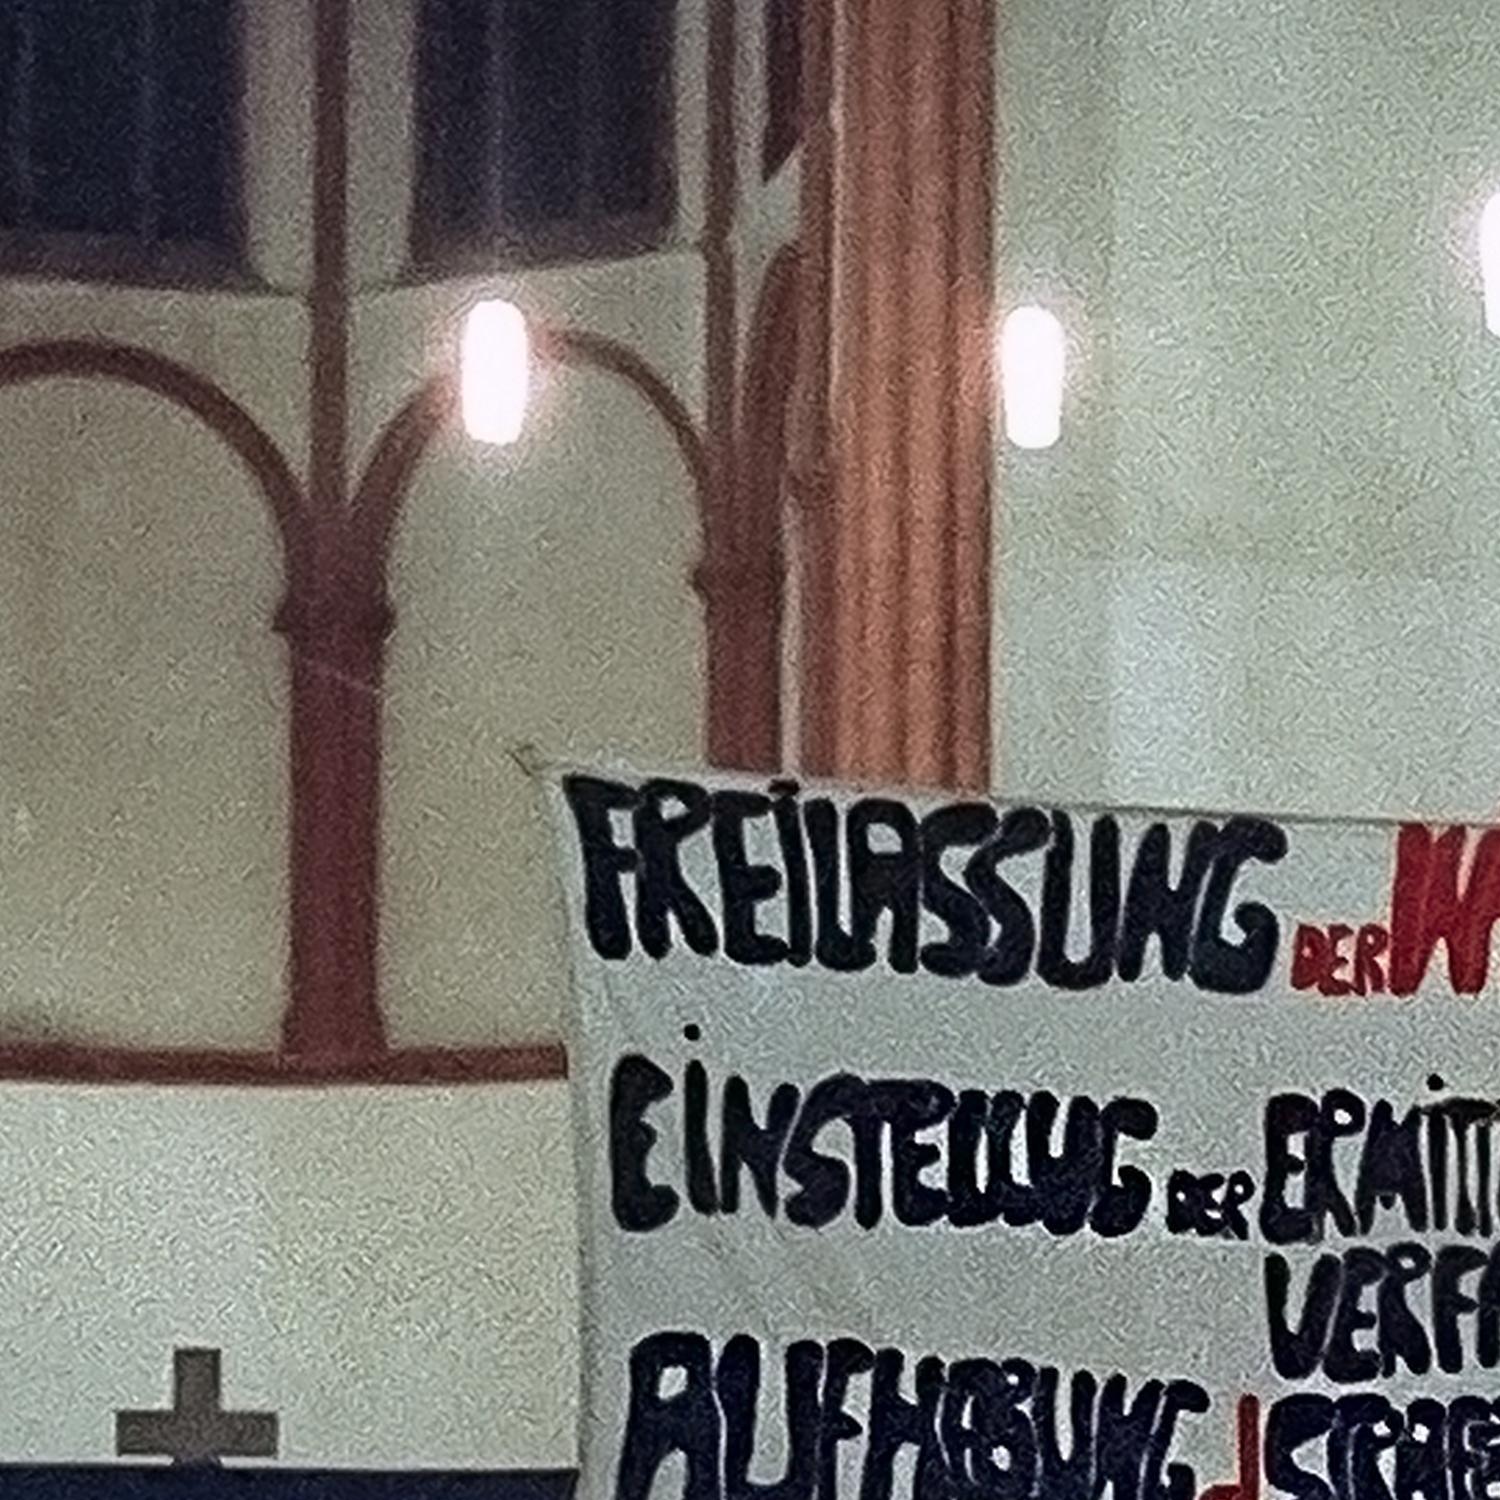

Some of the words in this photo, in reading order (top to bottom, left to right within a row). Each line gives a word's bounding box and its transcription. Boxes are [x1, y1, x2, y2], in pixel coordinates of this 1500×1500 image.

[562, 775, 1286, 993] FREILASSUNG
[1290, 923, 1388, 997] DER
[1164, 1168, 1256, 1240] DER
